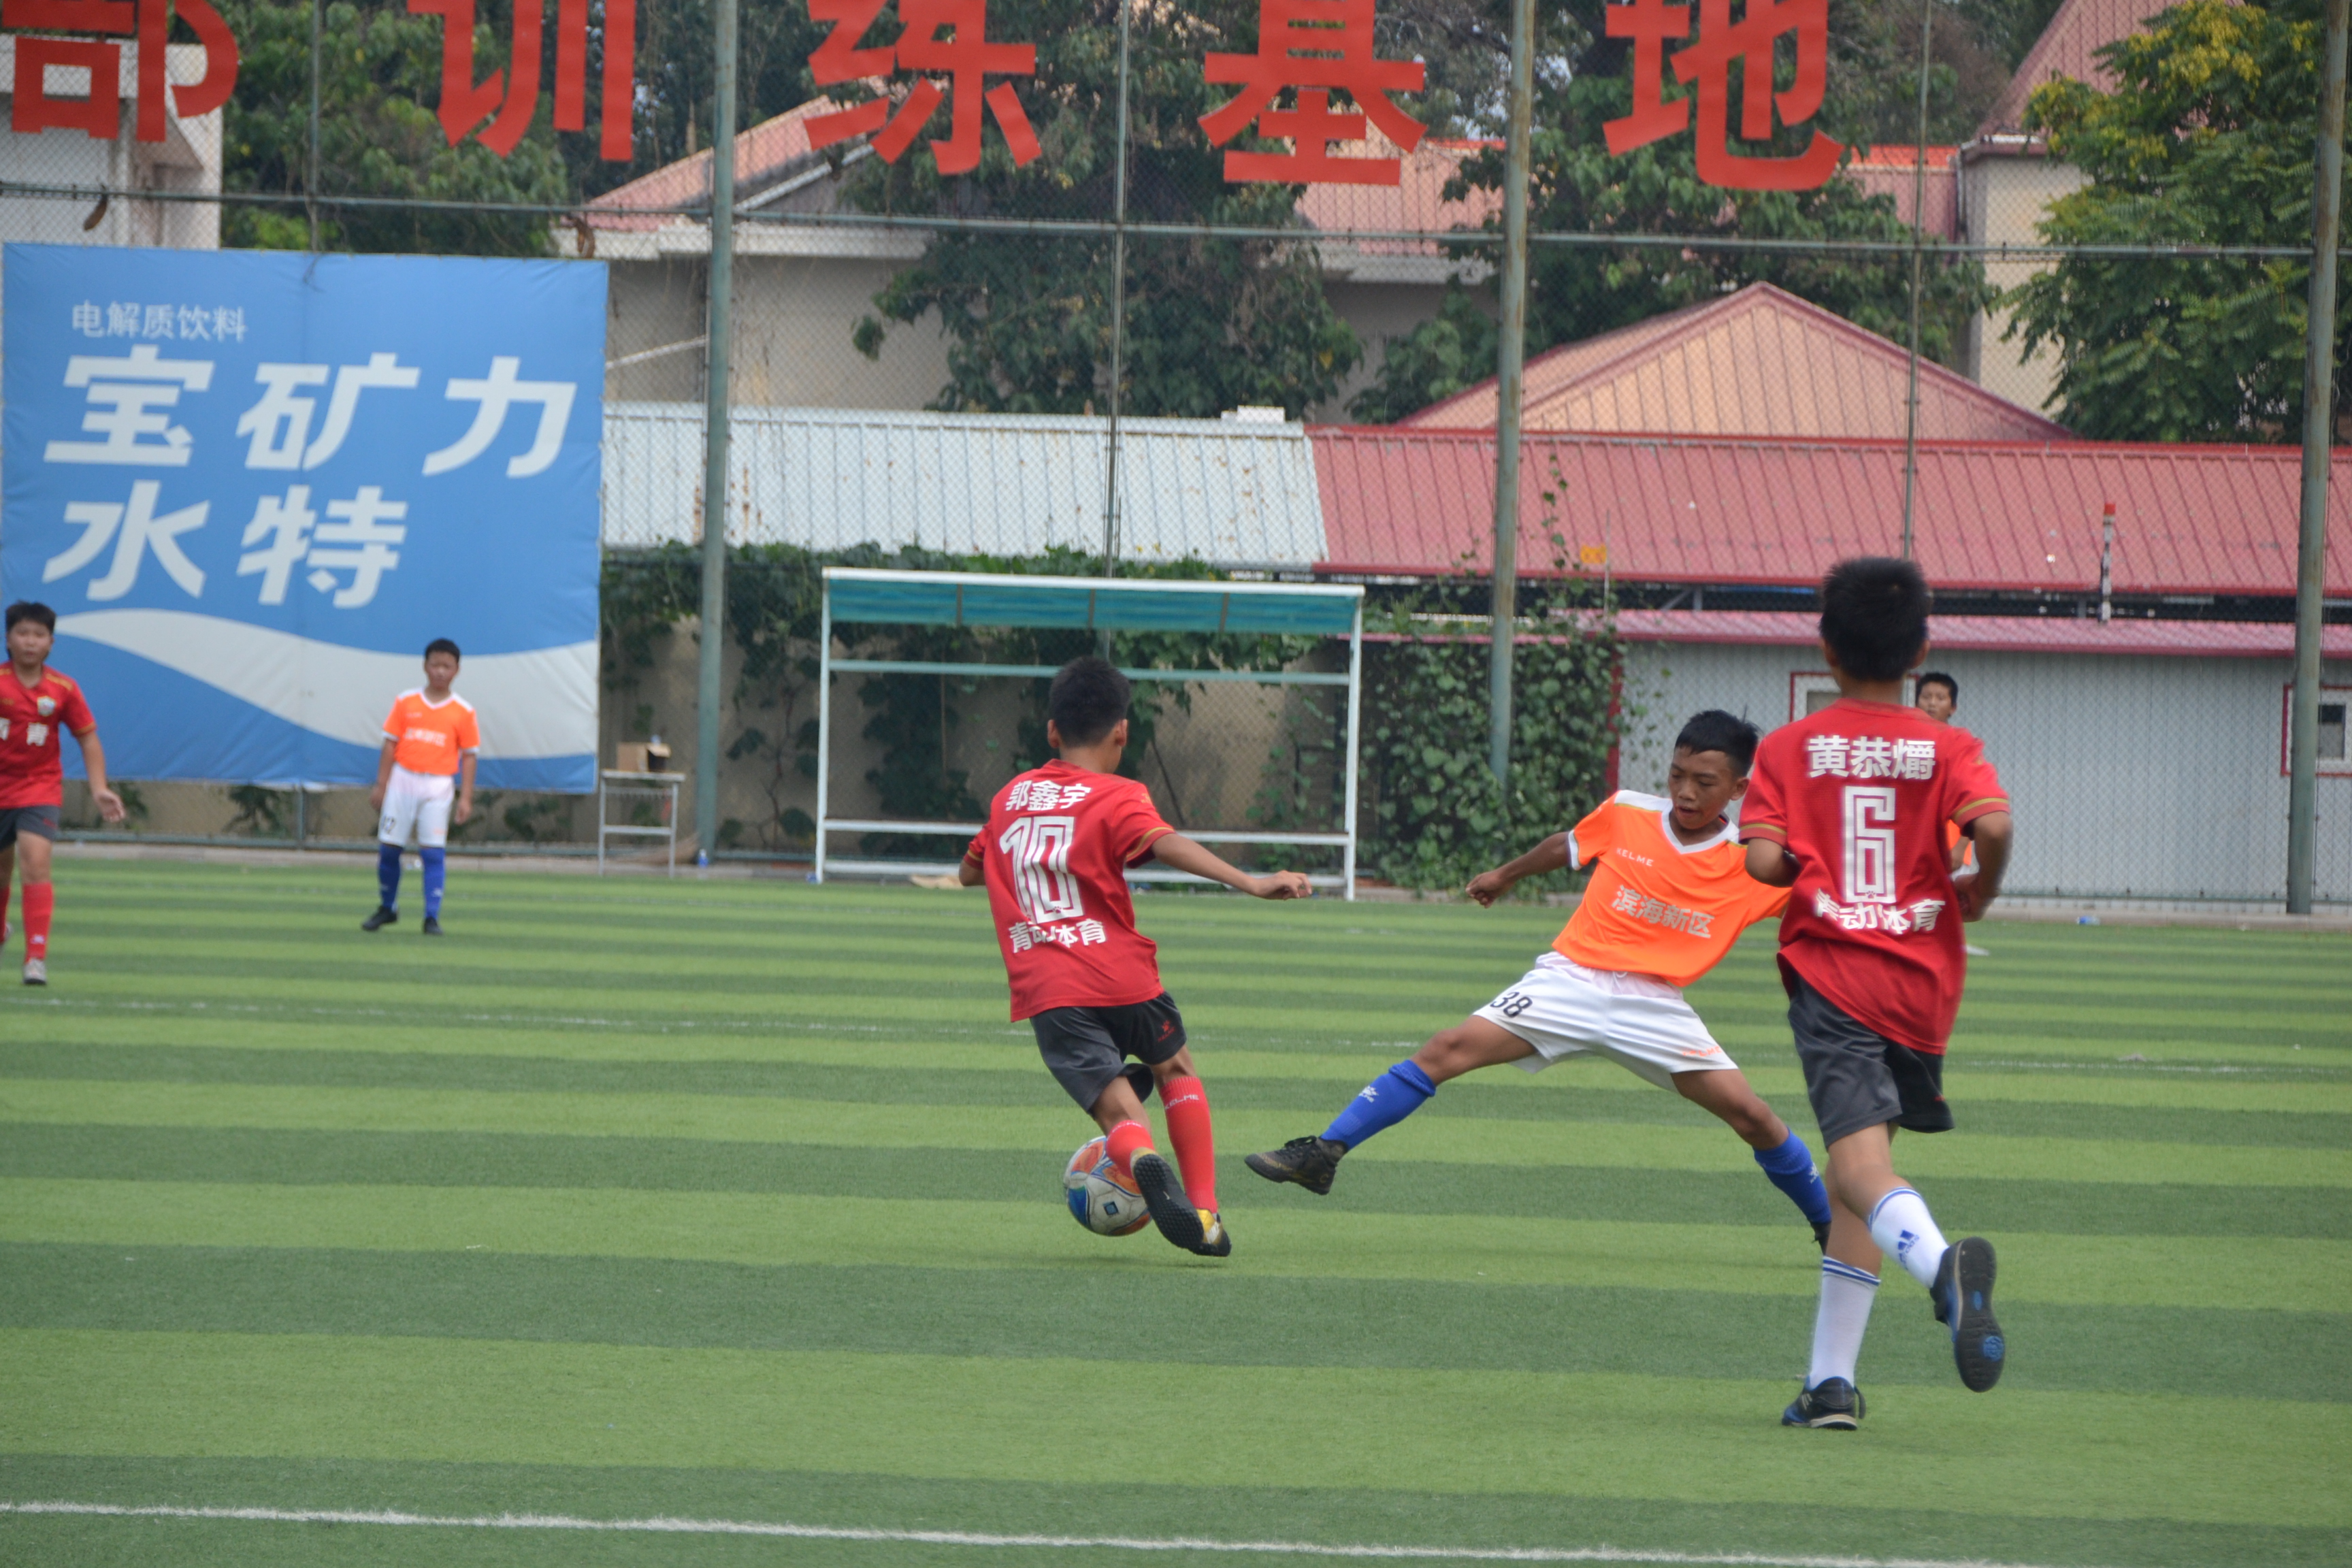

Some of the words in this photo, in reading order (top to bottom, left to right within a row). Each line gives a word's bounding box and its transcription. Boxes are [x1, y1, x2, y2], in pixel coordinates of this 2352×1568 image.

[71, 300, 247, 342] 电解质饮料
[43, 344, 578, 478] 宝矿力
[42, 480, 408, 608] 水特
[1006, 780, 1092, 811] 郭鑫宇
[1616, 847, 1654, 866] KELME
[1845, 785, 1895, 904] 6
[1000, 816, 1083, 924] 10
[1612, 885, 1715, 938] 滨海新区
[1816, 887, 1946, 934] 青动体育
[1490, 992, 1533, 1018] 38
[1164, 1094, 1199, 1110] KELME
